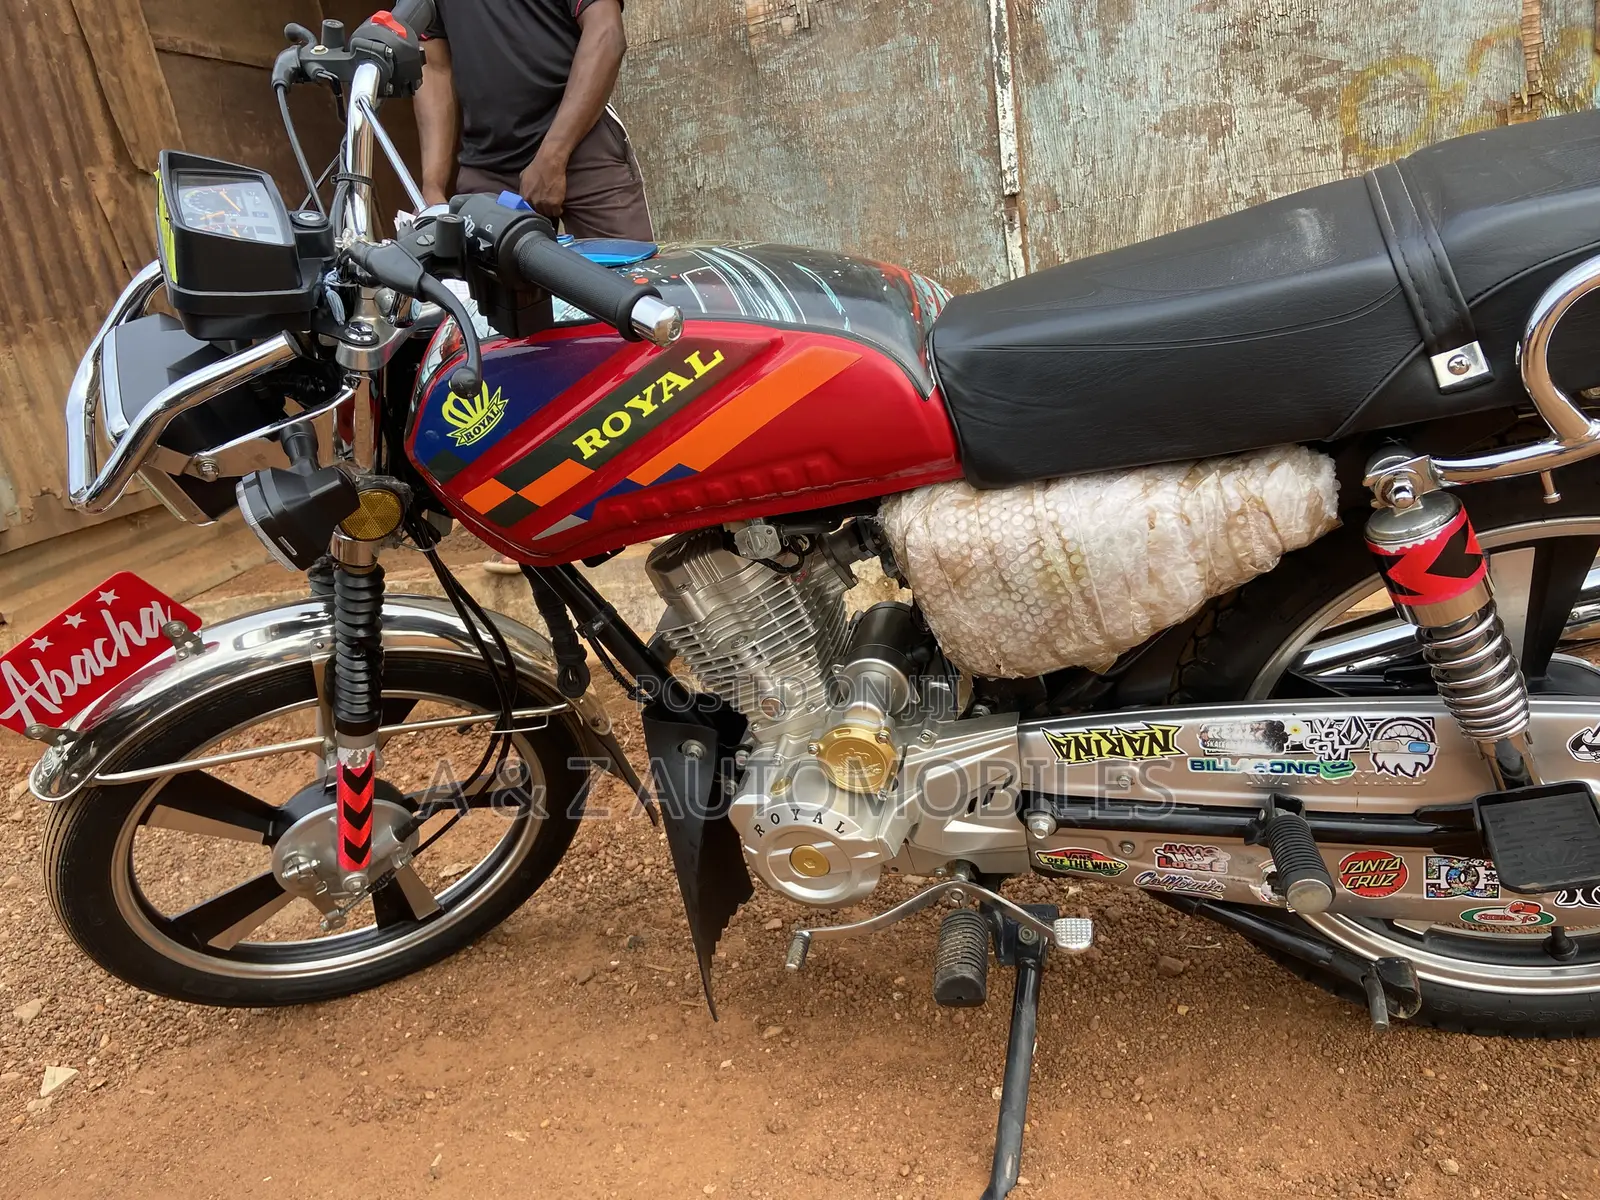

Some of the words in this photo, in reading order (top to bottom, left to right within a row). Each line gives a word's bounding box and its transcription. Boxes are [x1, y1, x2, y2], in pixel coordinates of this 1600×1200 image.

[572, 349, 725, 460] ROYAL
[463, 406, 502, 442] ROYAL
[0, 600, 173, 728] Abacha
[1190, 759, 1320, 775] BILLONG
[753, 808, 846, 838] ROYAL
[1067, 859, 1090, 869] THE
[1341, 856, 1403, 875] SANTA
[1345, 872, 1400, 889] CRUZ
